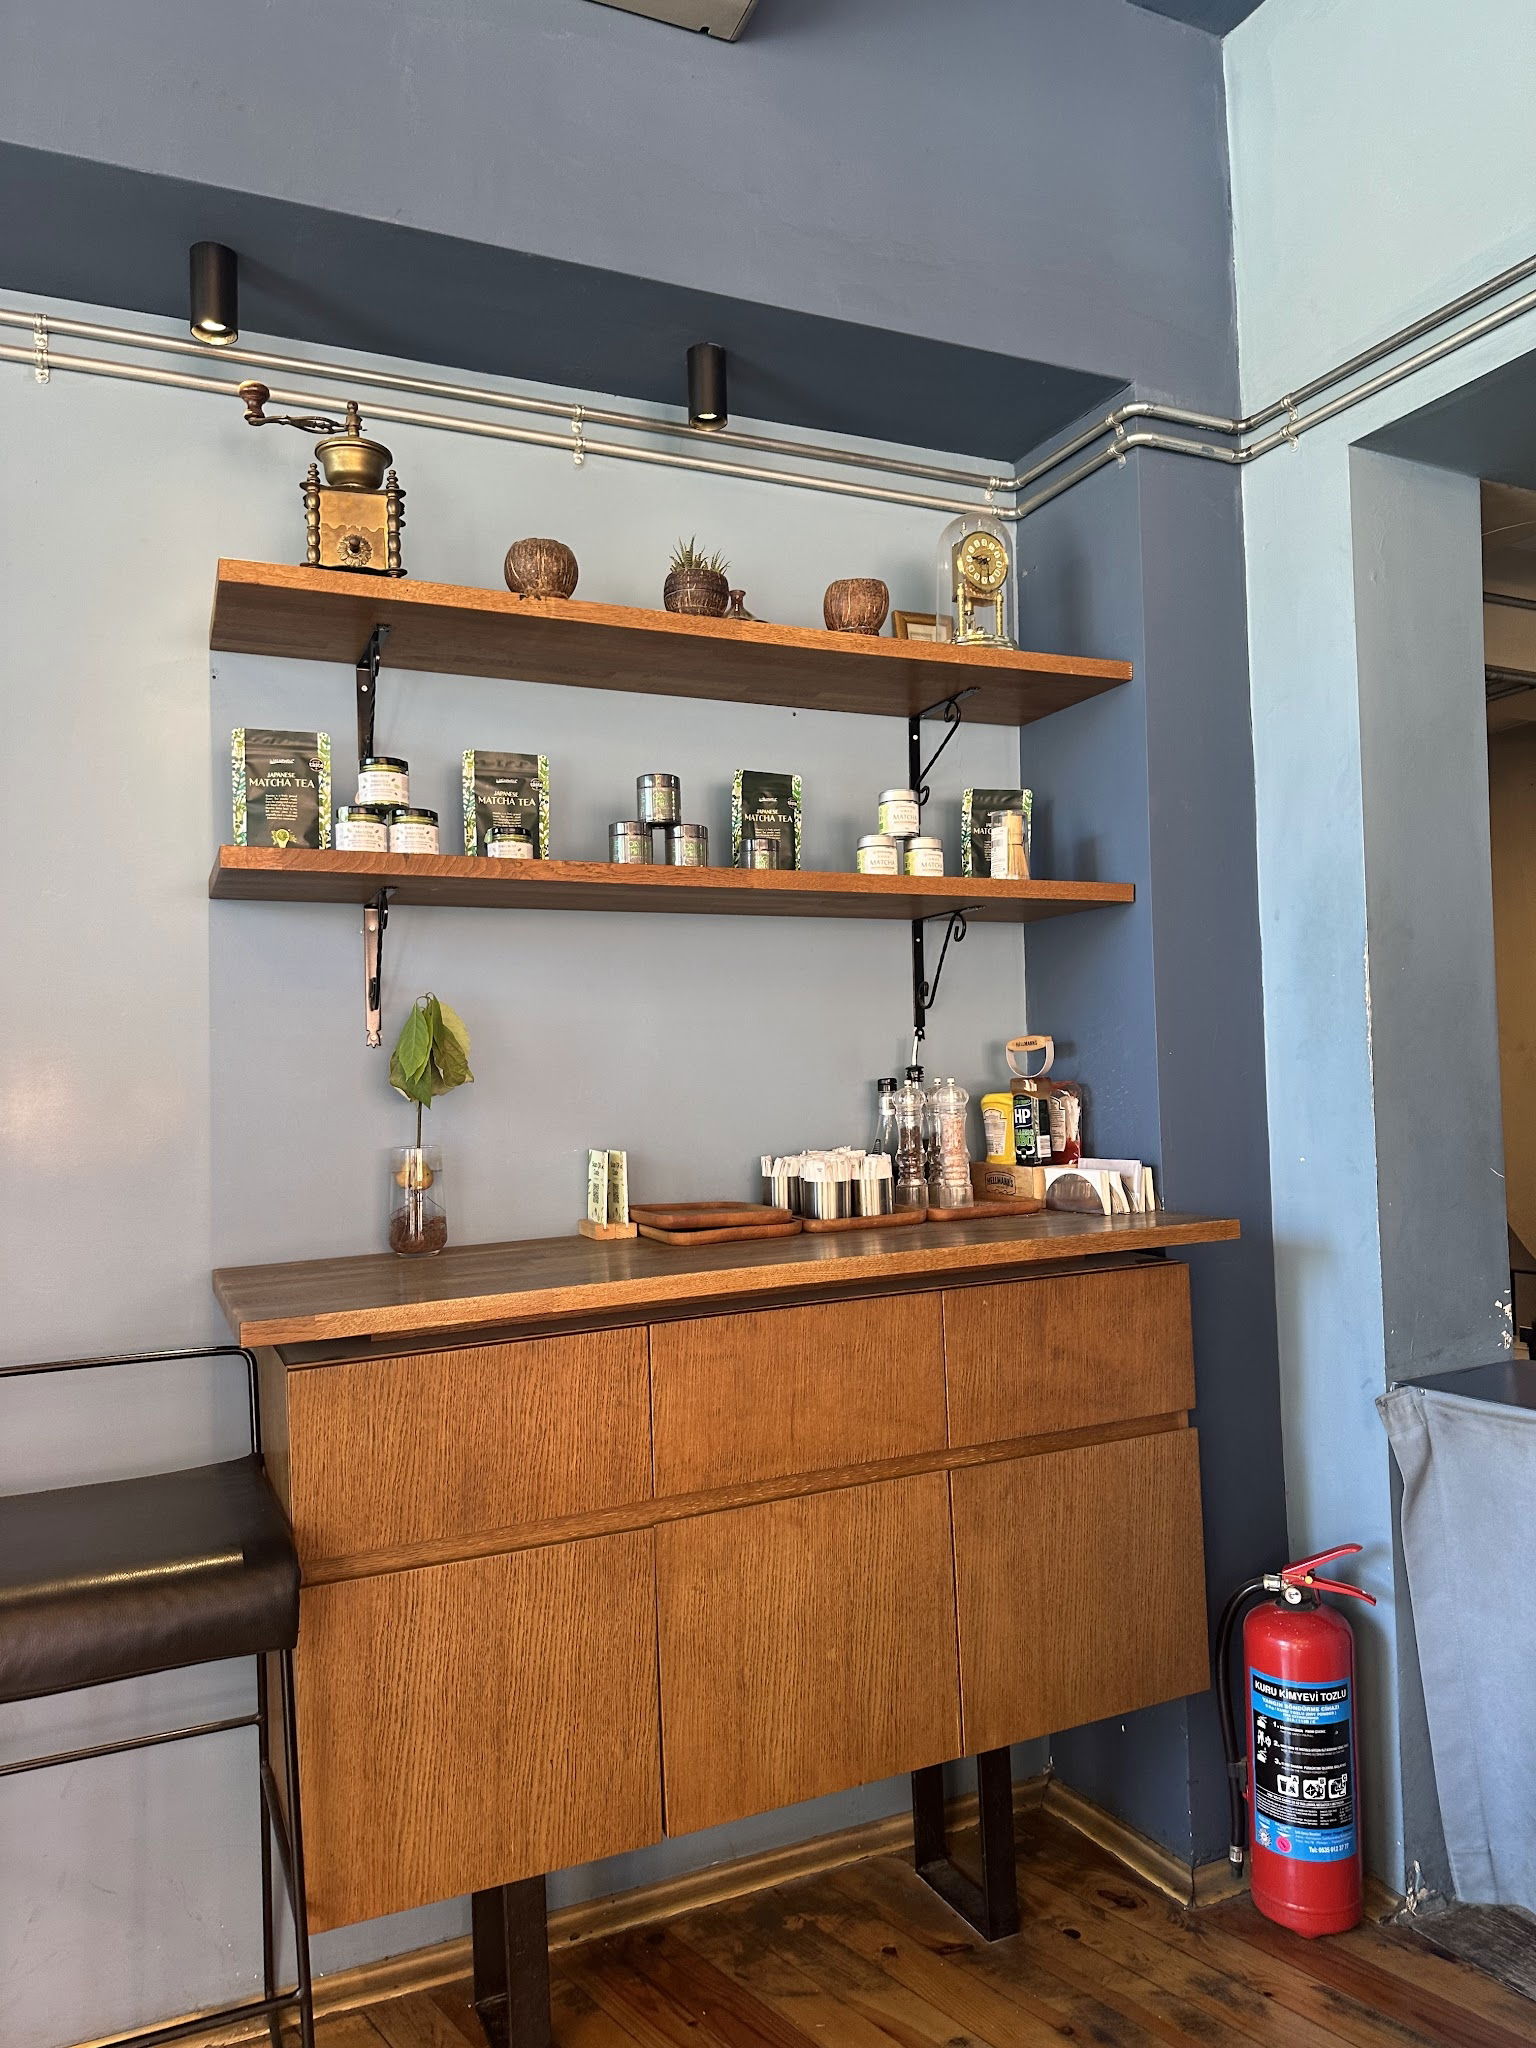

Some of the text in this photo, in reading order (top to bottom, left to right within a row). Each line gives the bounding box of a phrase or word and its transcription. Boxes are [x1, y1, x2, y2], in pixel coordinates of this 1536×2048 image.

[249, 778, 315, 789] MATCHA TEA
[493, 790, 519, 798] JAPANESE
[478, 796, 536, 807] MATCHA TEA
[744, 813, 793, 823] MATCHA TEA
[973, 827, 991, 835] MATC
[1015, 1108, 1031, 1124] HP
[1254, 1679, 1347, 1703] KURU KİMYEVİ TOZLU
